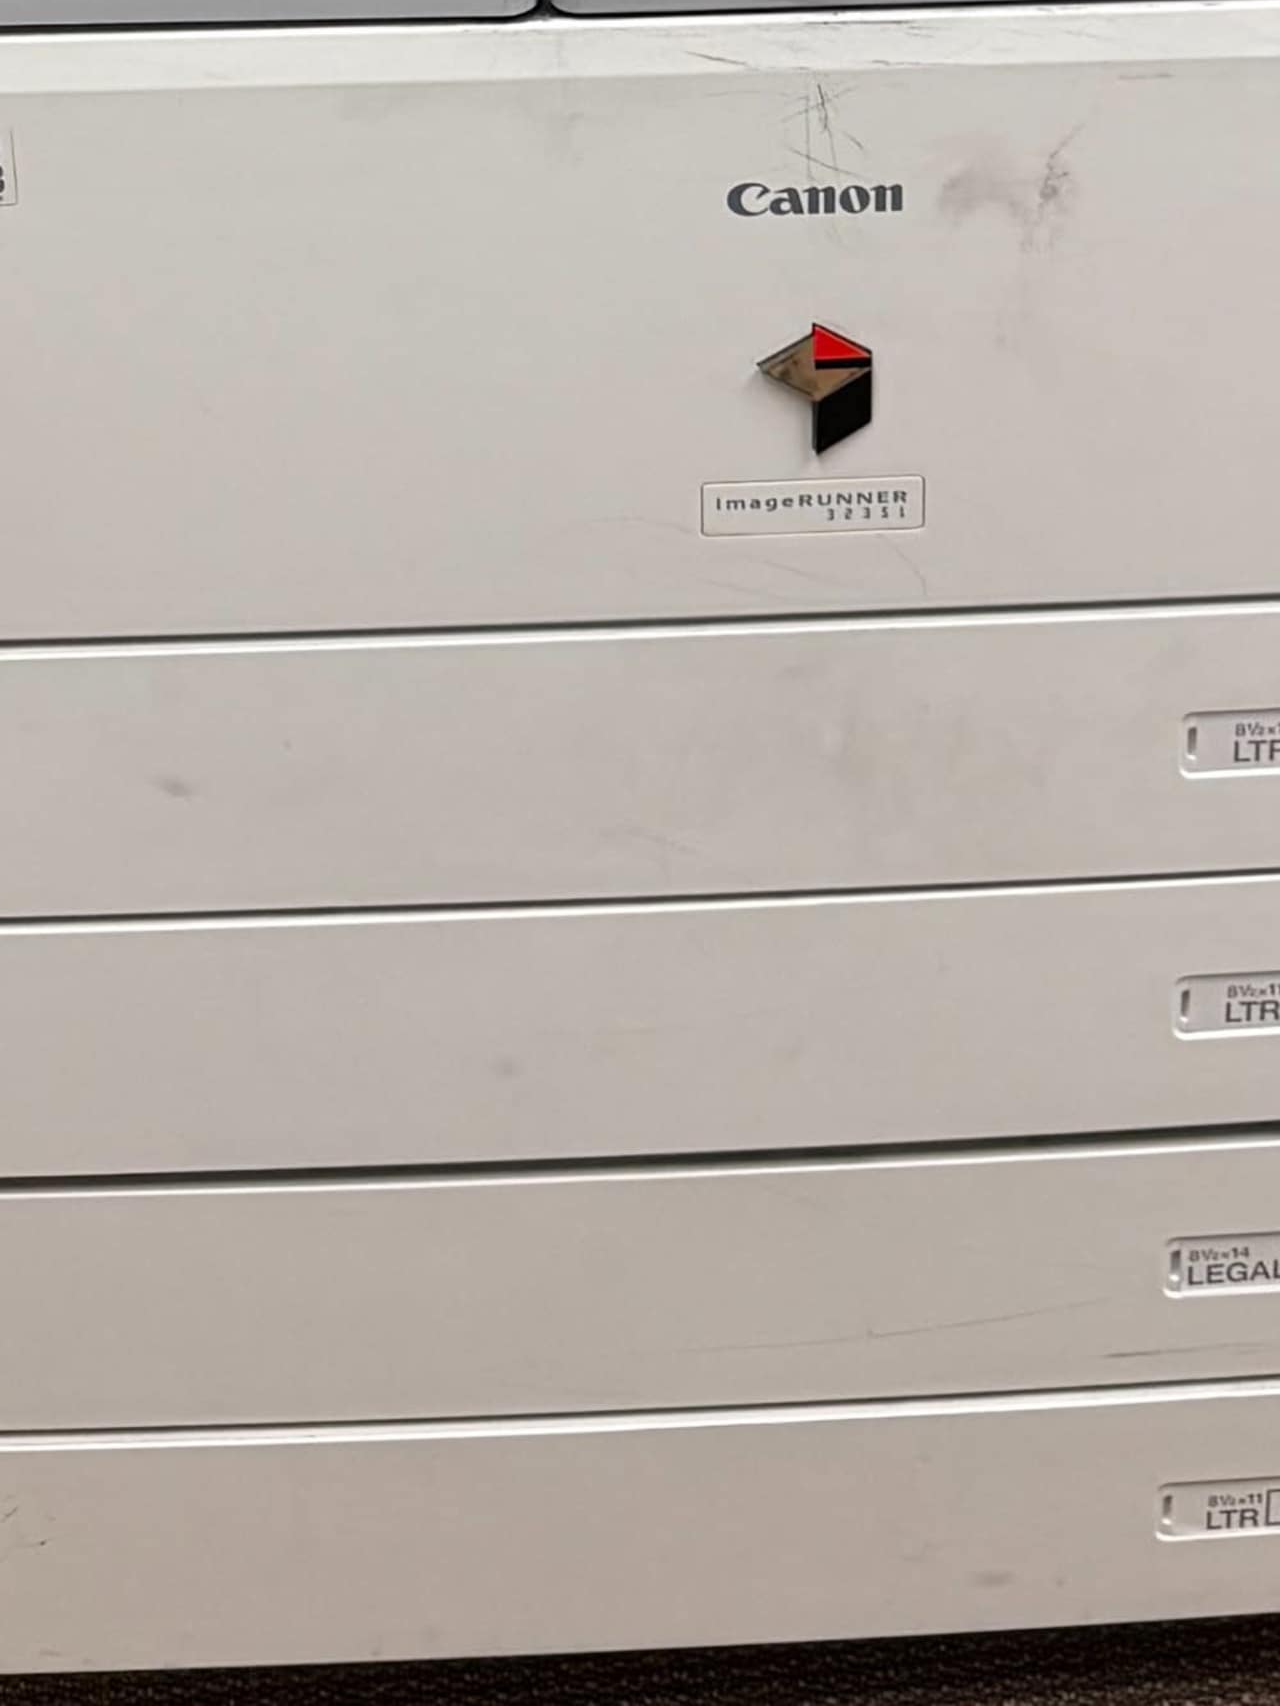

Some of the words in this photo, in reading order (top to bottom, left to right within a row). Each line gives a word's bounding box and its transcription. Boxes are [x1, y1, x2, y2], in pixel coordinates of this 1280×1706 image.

[727, 182, 903, 217] Canon
[1225, 1000, 1280, 1022] LTR
[1206, 1508, 1259, 1529] LTR
